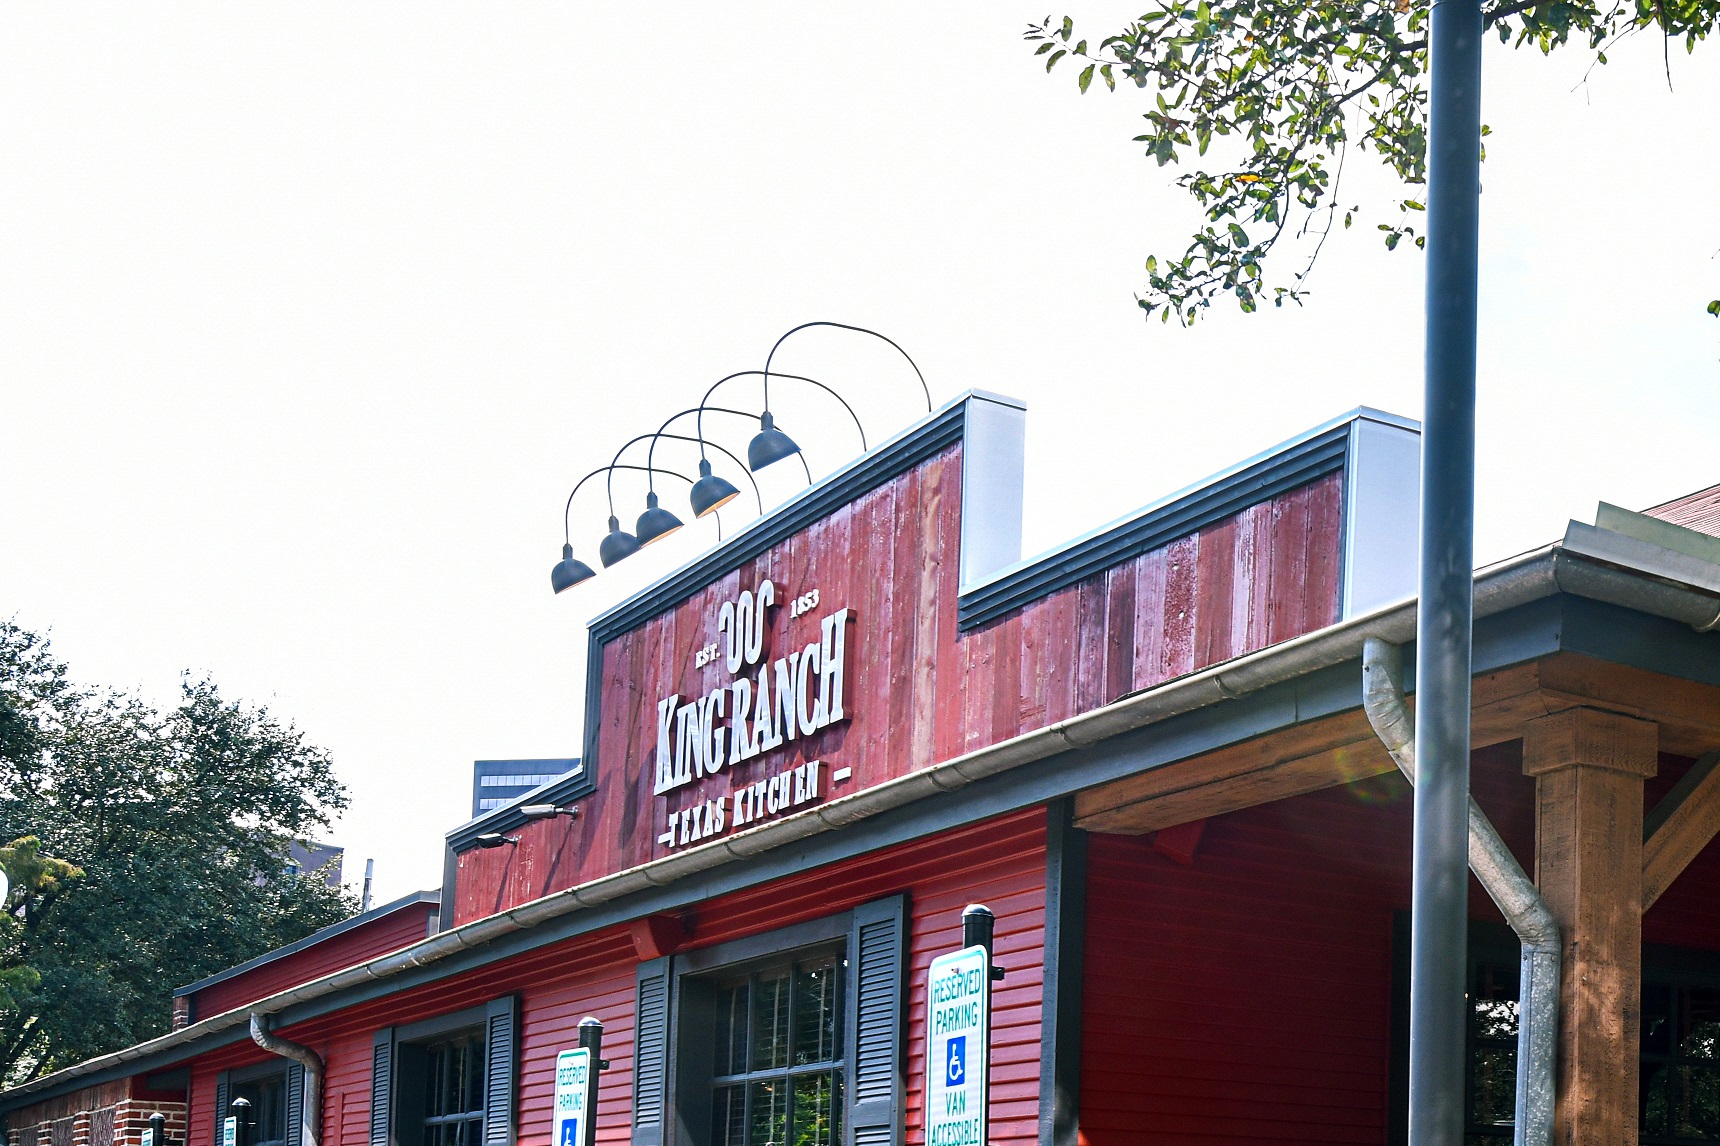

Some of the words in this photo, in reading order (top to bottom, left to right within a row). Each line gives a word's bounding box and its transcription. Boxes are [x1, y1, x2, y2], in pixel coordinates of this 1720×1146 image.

[790, 589, 819, 618] 1853
[695, 643, 720, 669] EST.
[654, 688, 725, 796] KING
[729, 608, 849, 766] RANCH
[668, 796, 726, 847] TEXAS
[732, 760, 820, 826] KITCHEN
[934, 968, 981, 1004] RESERVED
[936, 1002, 978, 1035] PARKING
[558, 1065, 586, 1086] RESERVED
[558, 1092, 583, 1113] PARKING
[945, 1089, 966, 1117] VAN
